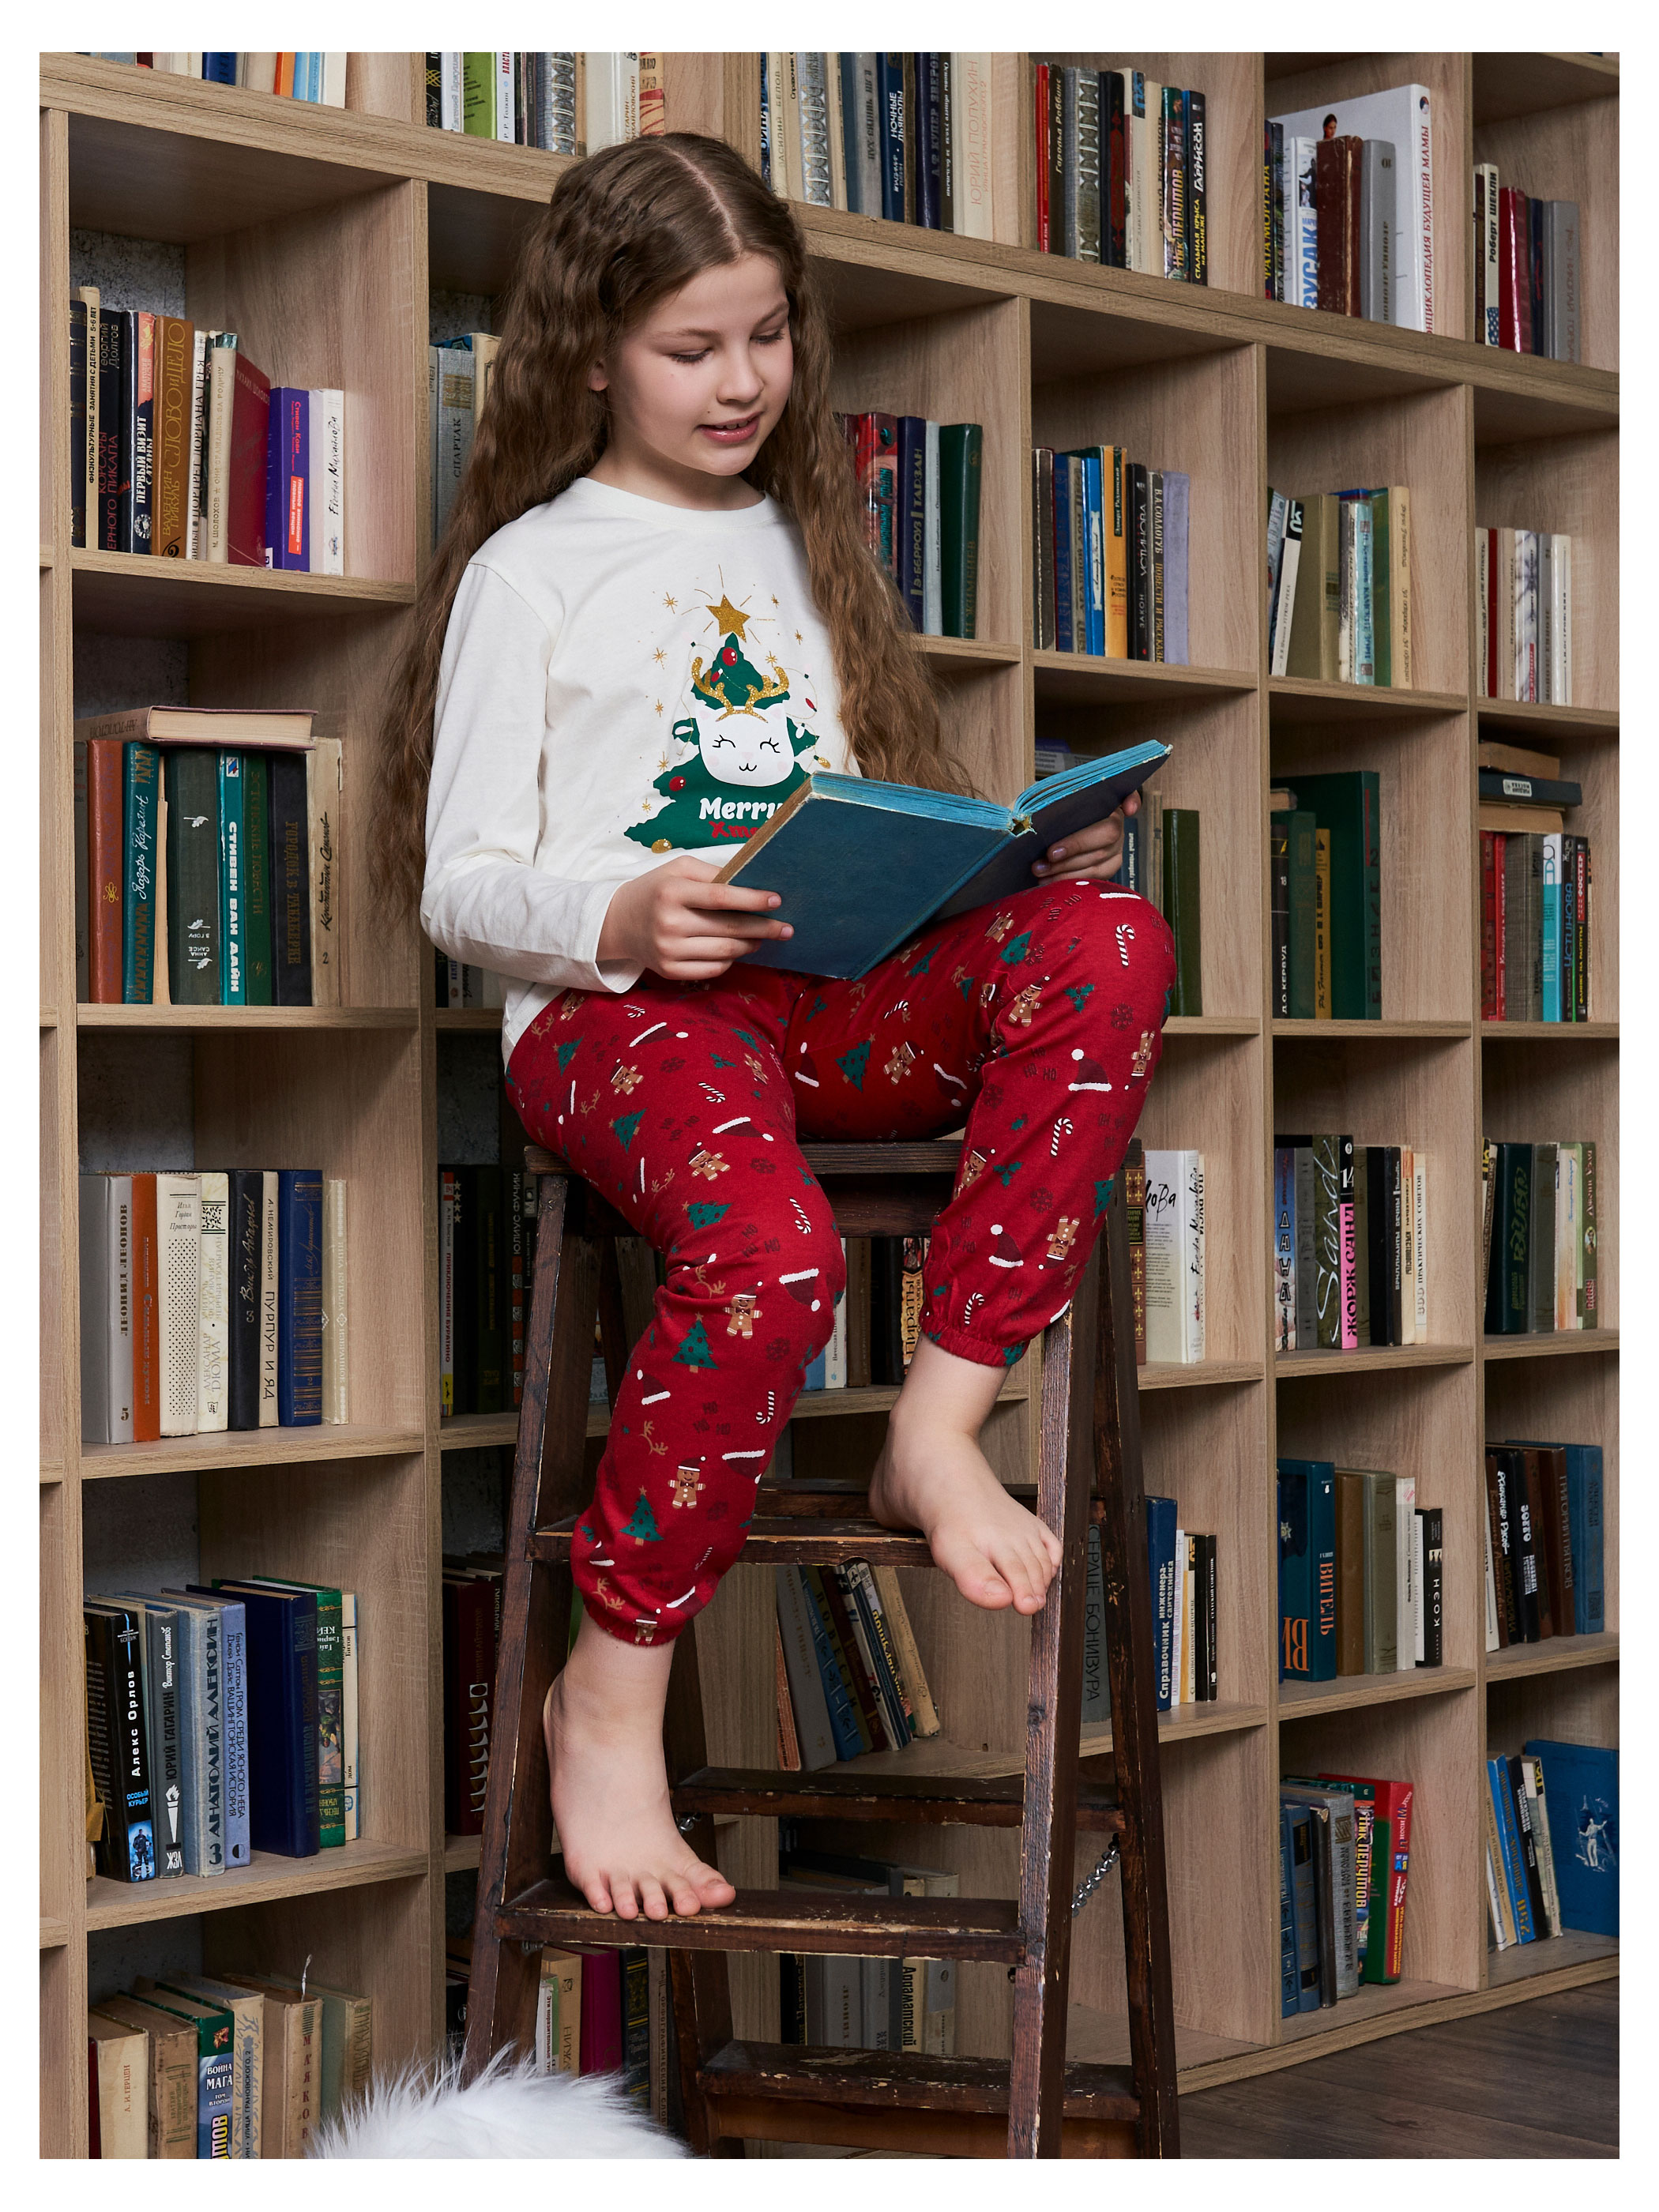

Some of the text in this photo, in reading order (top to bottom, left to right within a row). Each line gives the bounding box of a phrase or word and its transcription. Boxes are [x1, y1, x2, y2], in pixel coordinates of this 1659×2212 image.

[967, 60, 982, 205] ЮРИЙ ПОЛУХИН
[1193, 122, 1204, 192] ГАРРИСОН
[1421, 126, 1431, 231] БУДУЩЕЙ МАМЫ
[100, 323, 109, 373] Георгий
[110, 325, 119, 368] Долгов
[164, 323, 186, 467] СЛОВО ДЕЛО
[99, 431, 107, 493] КОРСАРЫ
[107, 435, 118, 493] ПИКАПА
[136, 416, 146, 503] ПЕРВЫЙ ВИЗИТ
[191, 359, 205, 517] ПОРТРЕТ ДОРИАНА ГРЕЯ
[162, 470, 172, 535] ВАЛЕНТИН
[170, 480, 180, 528] ПИКУЛЬ
[913, 449, 923, 507] ТАРЗАН
[698, 796, 788, 825] Merry
[132, 796, 150, 899] Лазарь Карелин
[228, 822, 240, 991] СТИВЕН ВАН ДАЙН
[284, 822, 301, 964] ГОРОДОК ТАБАКЕРКЕ
[512, 1173, 522, 1255] ЮЛИУС ФУЧИК
[1314, 1139, 1339, 1342] Sand
[264, 1292, 275, 1352] ПУРПУР
[904, 1281, 916, 1355] Пираты
[1345, 1269, 1357, 1336] ЖОРЖ
[212, 1341, 222, 1392] ДЮМА
[263, 1378, 274, 1399] ЯД
[265, 1360, 274, 1371] И
[121, 1408, 129, 1420] 5
[1319, 1563, 1334, 1635] ВИГЕЛЬ
[1085, 1604, 1100, 1701] БОНИВУРА
[1159, 1622, 1171, 1699] Справочник
[126, 1671, 141, 1777] Алекс Орлов
[160, 1627, 176, 1780] ЮРИЙ ГАГАРИН Виктор Степанов
[206, 1619, 220, 1837] АНАТОЛИЙ АЛЕКСИН
[228, 1687, 236, 1769] ВАШИНГТОНСКАЯ
[127, 1789, 149, 1800] ОСОБЫЙ
[128, 1798, 149, 1807] КУРЬЕР
[236, 1754, 245, 1792] ЯСНОГО
[206, 2075, 232, 2090] МАГА
[207, 2063, 231, 2075] ВОЙНА
